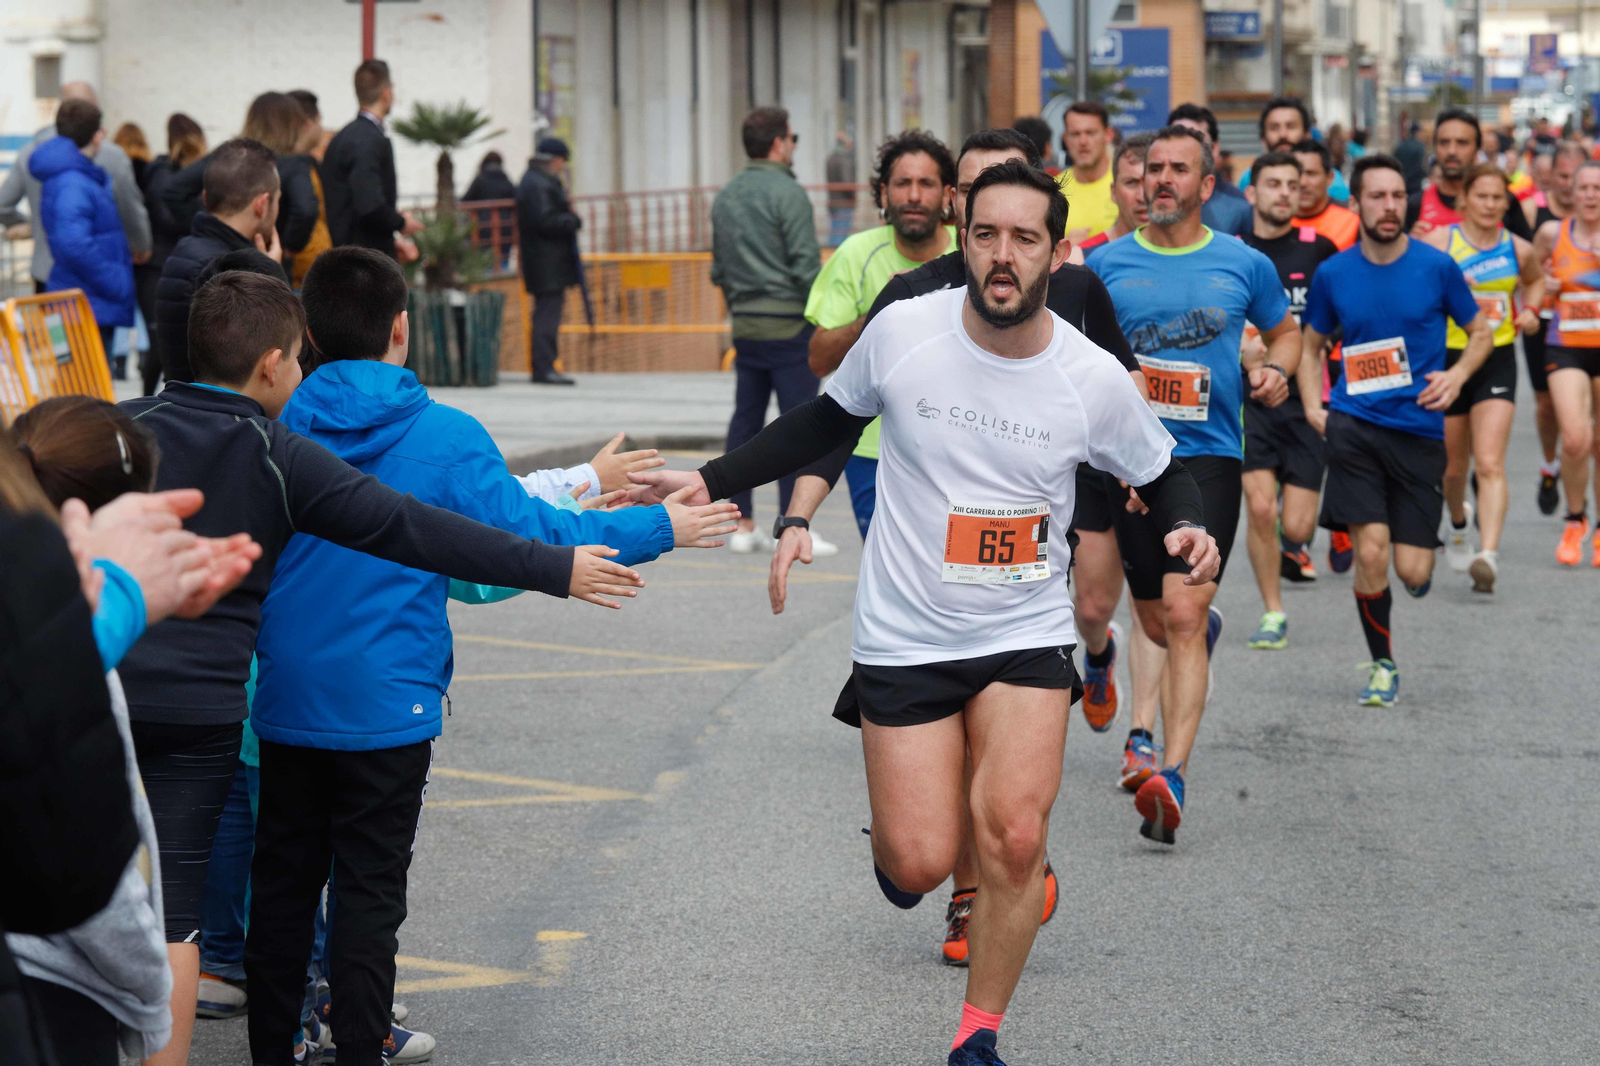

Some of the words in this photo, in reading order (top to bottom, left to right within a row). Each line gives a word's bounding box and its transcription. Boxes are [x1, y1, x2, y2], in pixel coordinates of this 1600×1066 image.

[1357, 356, 1389, 380] 399
[1149, 377, 1182, 404] 316
[948, 420, 987, 434] CENTRO
[994, 432, 1049, 449] DEPORTIVO
[949, 406, 1051, 442] COLISEUM
[953, 505, 964, 513] XIII
[966, 507, 996, 516] CARREIRA
[989, 520, 1010, 528] MANU
[978, 530, 1016, 563] 65
